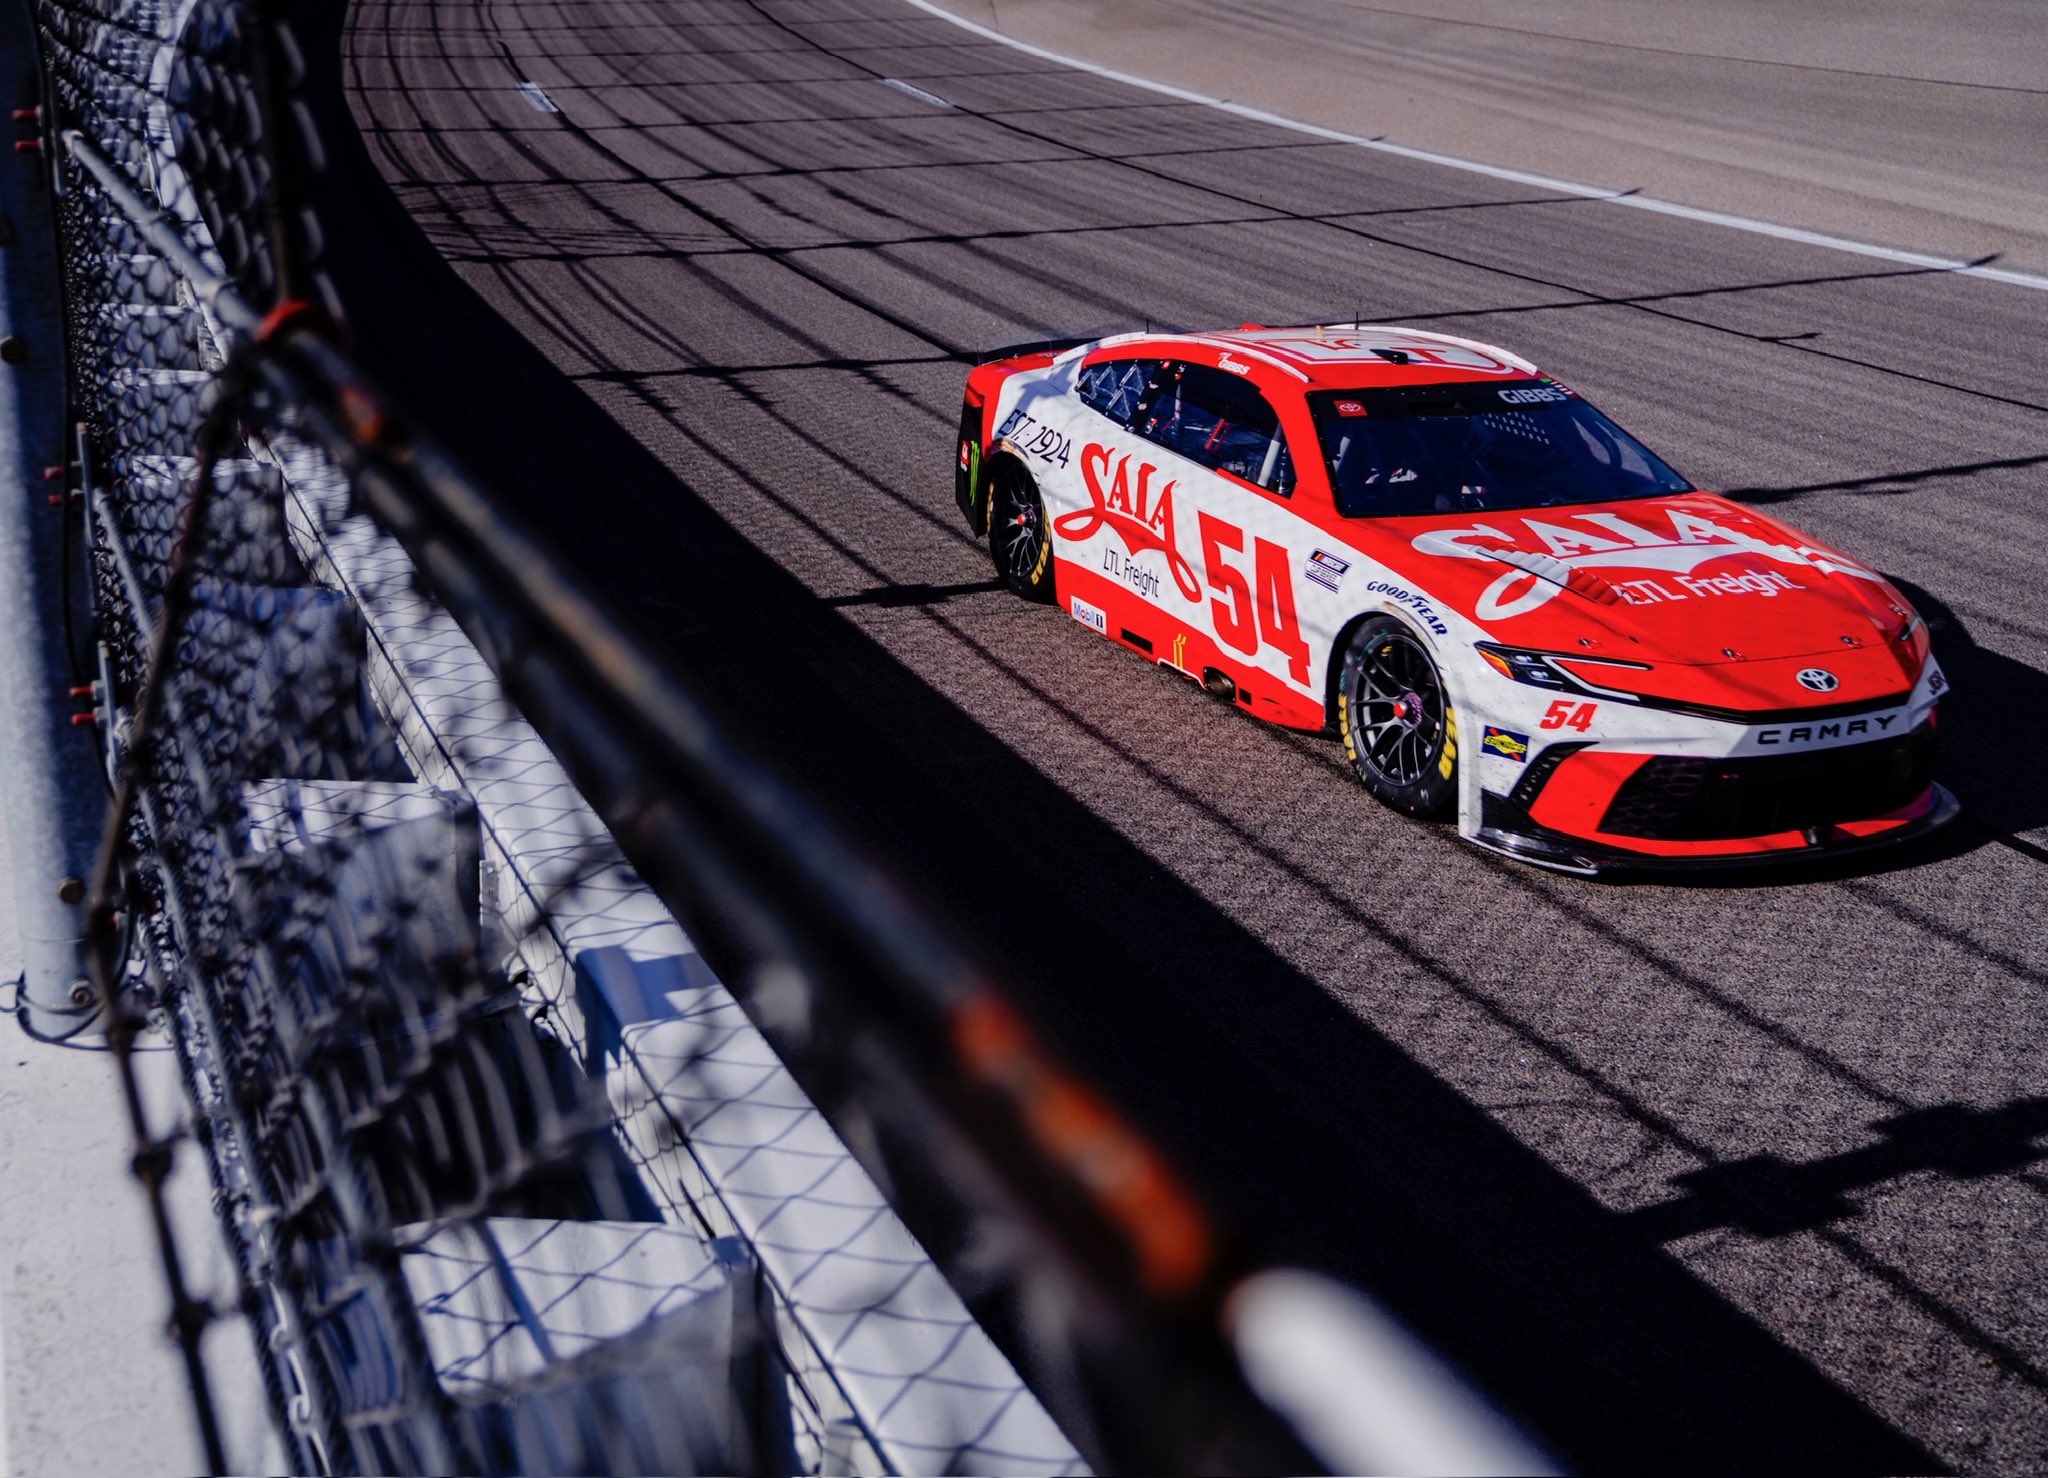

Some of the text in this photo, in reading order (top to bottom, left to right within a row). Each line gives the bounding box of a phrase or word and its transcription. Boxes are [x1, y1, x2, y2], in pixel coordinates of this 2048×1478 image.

[1218, 360, 1251, 375] GIBBS
[1498, 388, 1567, 404] GIBBS
[997, 408, 1071, 469] EST. 1924
[1053, 442, 1202, 603] SAIA
[1103, 547, 1160, 598] LTL Freight
[1411, 508, 1887, 621] SAIA
[1197, 510, 1312, 688] 54
[1366, 580, 1448, 635] GOODYEAR
[1611, 569, 1808, 605] LTL Freight
[1073, 602, 1104, 628] Mobil 1
[1539, 699, 1598, 732] 54
[1757, 714, 1898, 745] CAMRY
